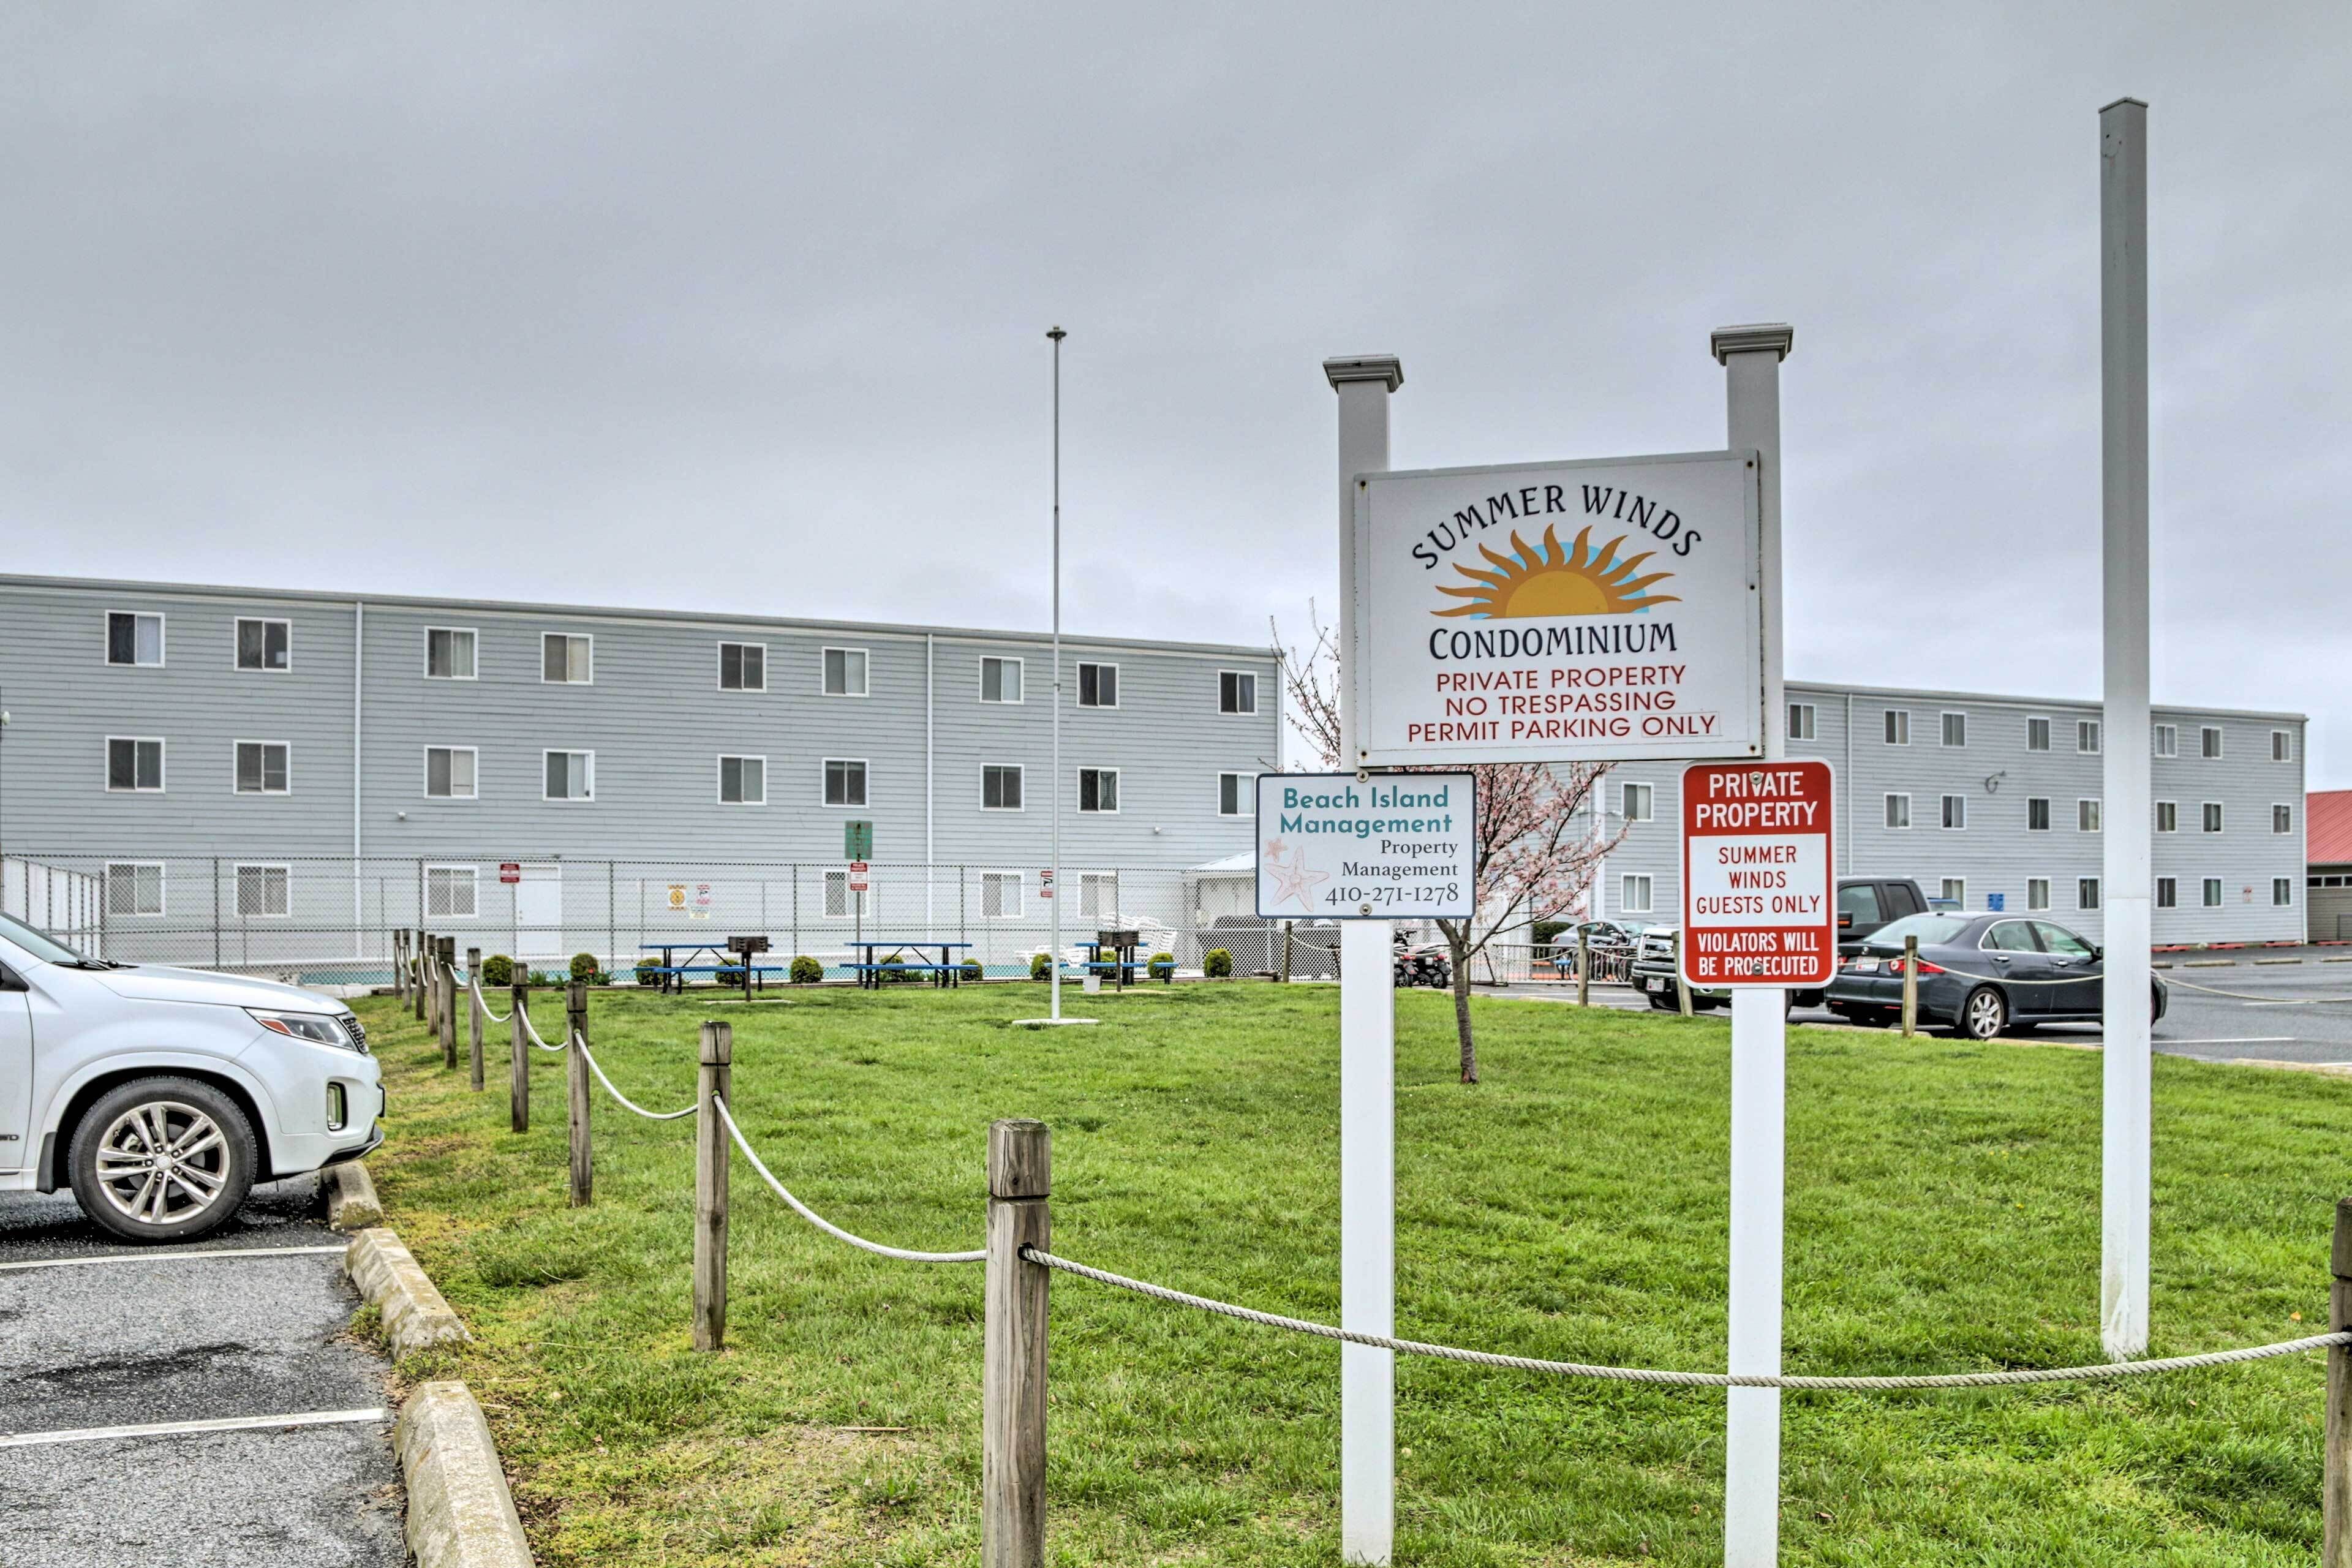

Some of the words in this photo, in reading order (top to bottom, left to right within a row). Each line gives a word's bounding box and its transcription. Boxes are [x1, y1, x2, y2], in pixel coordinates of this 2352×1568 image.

[1412, 484, 1566, 570] SUMMER
[1582, 485, 1701, 556] WINDS
[1429, 623, 1677, 660] CONDOMINIUM
[1437, 670, 1538, 692] PRIVATE
[1551, 665, 1686, 688] PROPERTY
[1446, 696, 1487, 716] NO
[1499, 691, 1676, 714] TRESPASSING
[1409, 722, 1499, 742] PERMIT
[1512, 717, 1630, 739] PARKING
[1643, 715, 1715, 735] ONLY
[1709, 772, 1803, 797] PRIVATE
[1284, 786, 1359, 809] Beach
[1372, 785, 1448, 808] Island
[1281, 812, 1452, 839] Management
[1696, 801, 1818, 827] PROPERTY
[1381, 840, 1458, 858] Property
[1719, 846, 1796, 864] SUMMER
[1343, 862, 1458, 880] Management
[1729, 872, 1786, 888] WINDS
[1325, 883, 1458, 906] 410-271-1278
[1697, 897, 1763, 914] GUESTS
[1773, 895, 1820, 912] ONLY
[1698, 933, 1777, 952] VIOLATORS
[1784, 932, 1819, 951] WILL
[1699, 957, 1716, 976] BE
